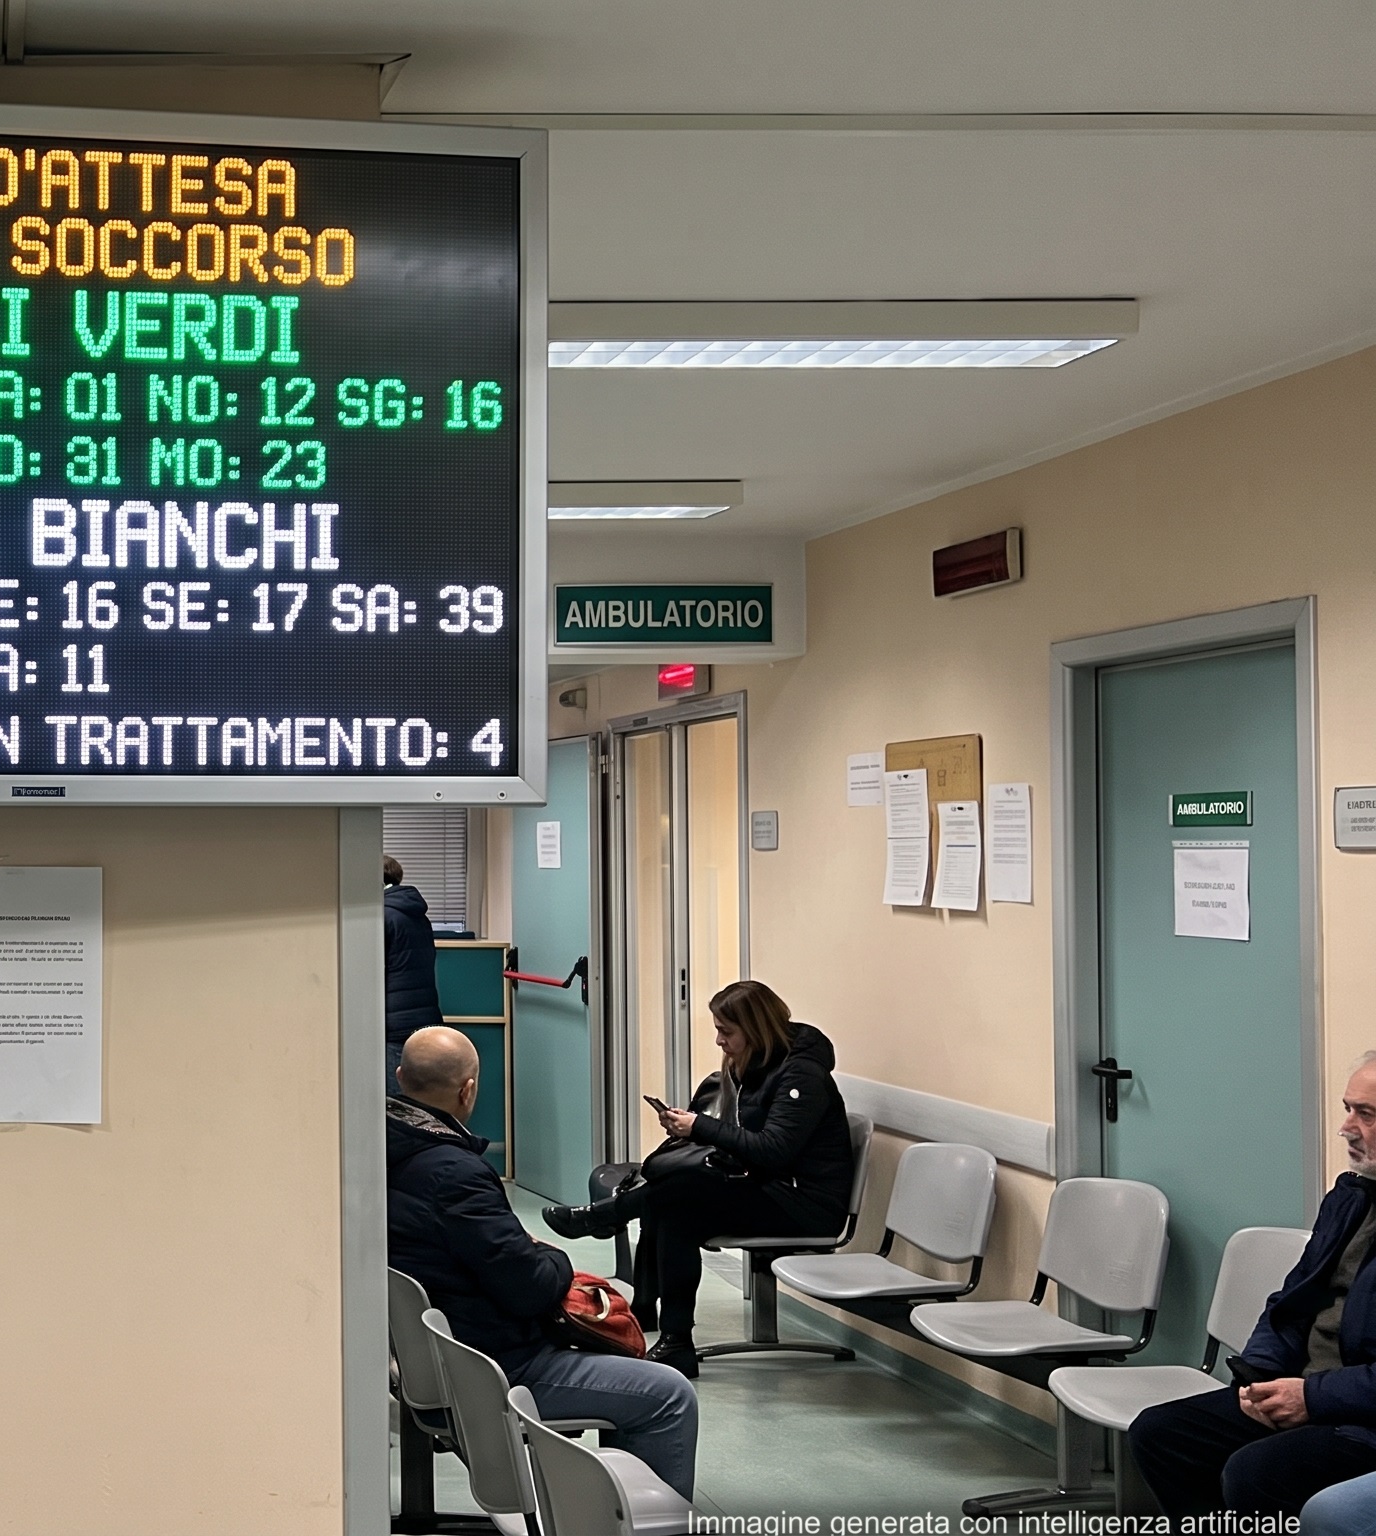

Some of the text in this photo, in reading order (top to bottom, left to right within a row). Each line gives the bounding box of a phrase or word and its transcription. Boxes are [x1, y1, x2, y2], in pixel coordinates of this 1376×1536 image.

[12, 216, 354, 286] SOCCORSO
[75, 290, 299, 364] VERDI
[66, 372, 121, 421] 01
[149, 374, 237, 423] NO:
[261, 377, 315, 426] 12
[338, 378, 423, 428] SG:
[446, 380, 502, 429] 16
[149, 437, 240, 487] MO:
[262, 440, 326, 489] 23
[32, 498, 339, 570] BIANCHI
[62, 581, 118, 629] 16
[143, 582, 229, 630] SE:
[252, 583, 308, 631] 17
[332, 584, 416, 632] SA:
[439, 585, 503, 633] 39
[564, 600, 764, 628] AMBULATORIO
[62, 644, 109, 692] 11
[45, 716, 448, 766] TRATTAMENTO:
[471, 719, 503, 766] 4
